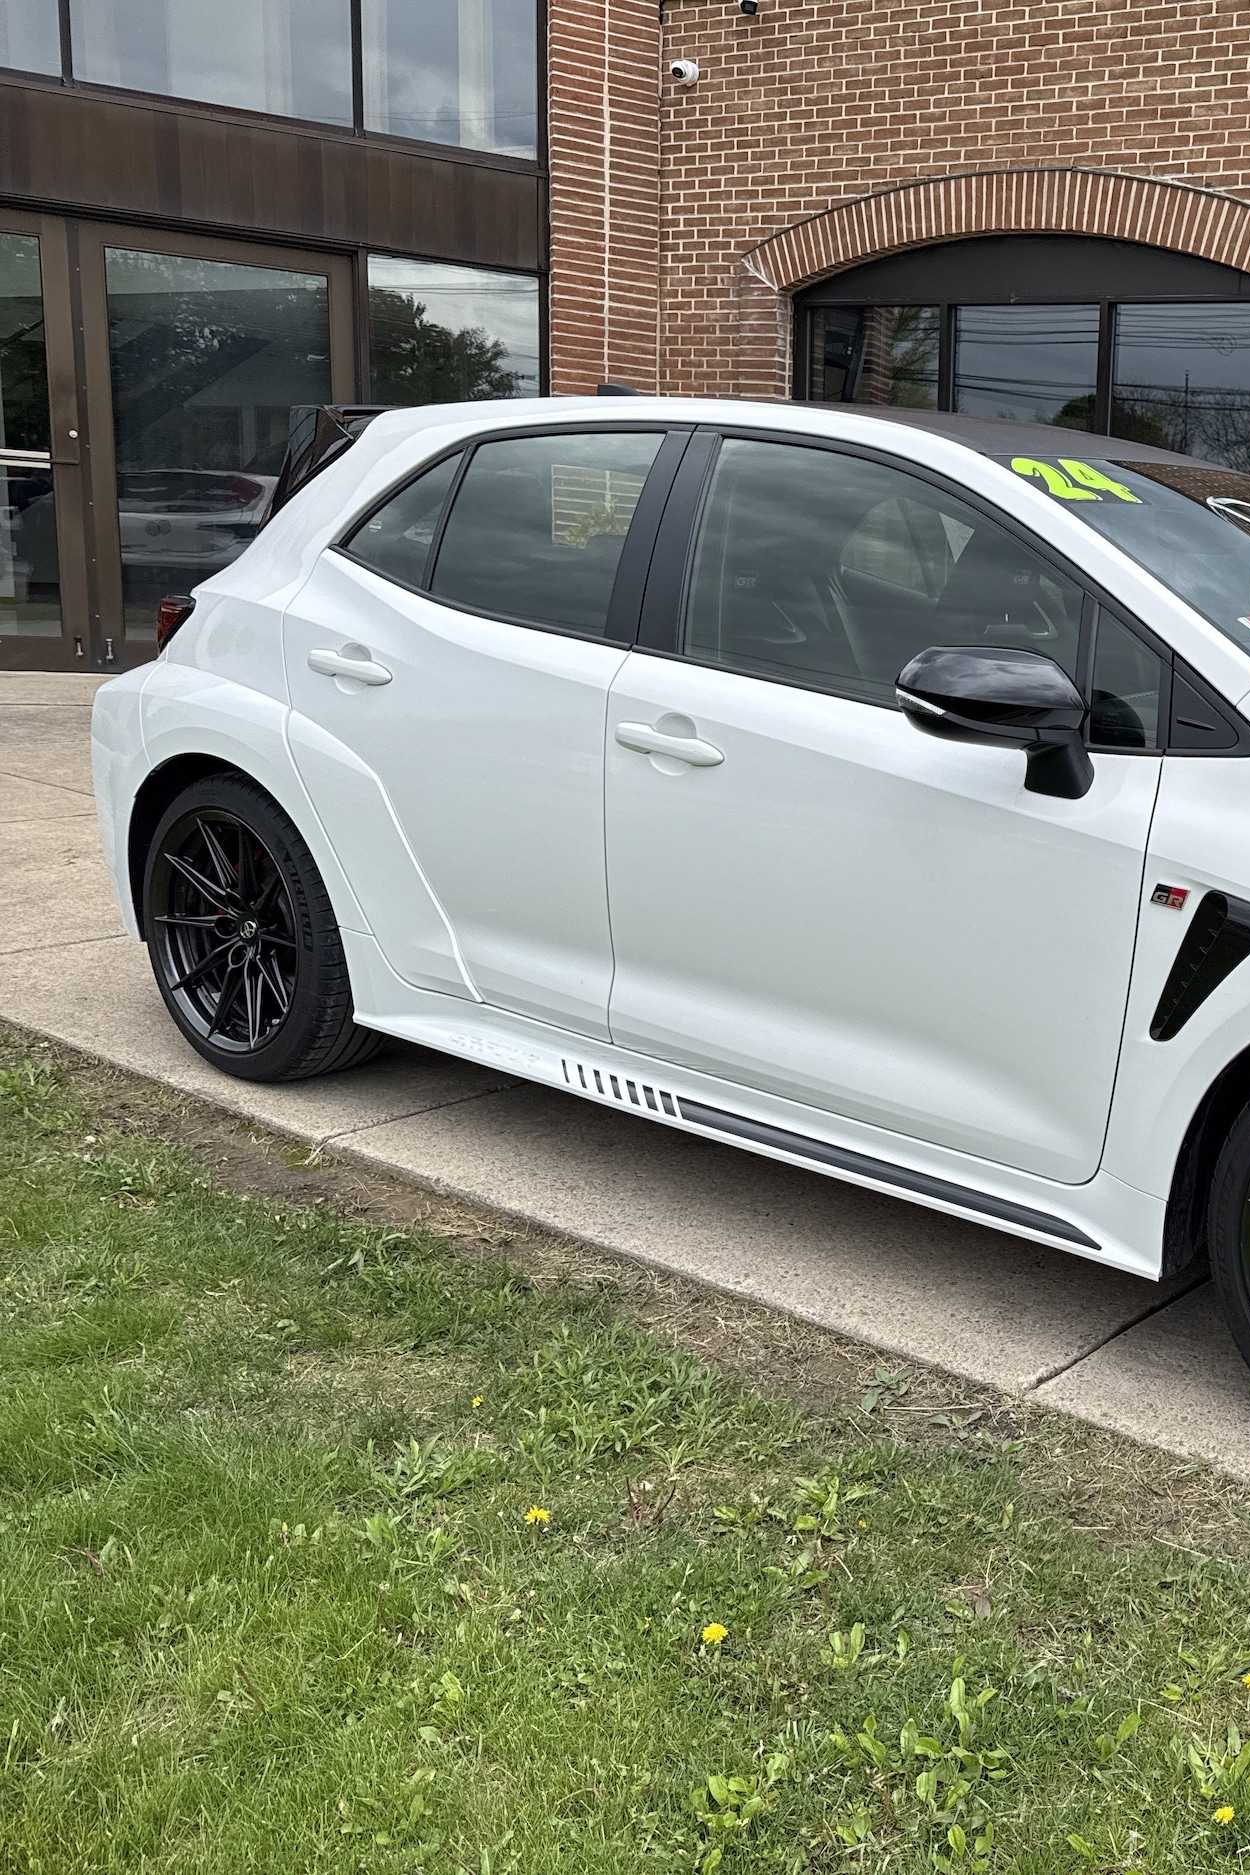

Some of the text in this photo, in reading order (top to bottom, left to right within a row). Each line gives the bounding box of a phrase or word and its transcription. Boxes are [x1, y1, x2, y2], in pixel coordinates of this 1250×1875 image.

[1011, 458, 1143, 504] 24
[736, 576, 757, 587] GR
[1152, 891, 1185, 908] GR
